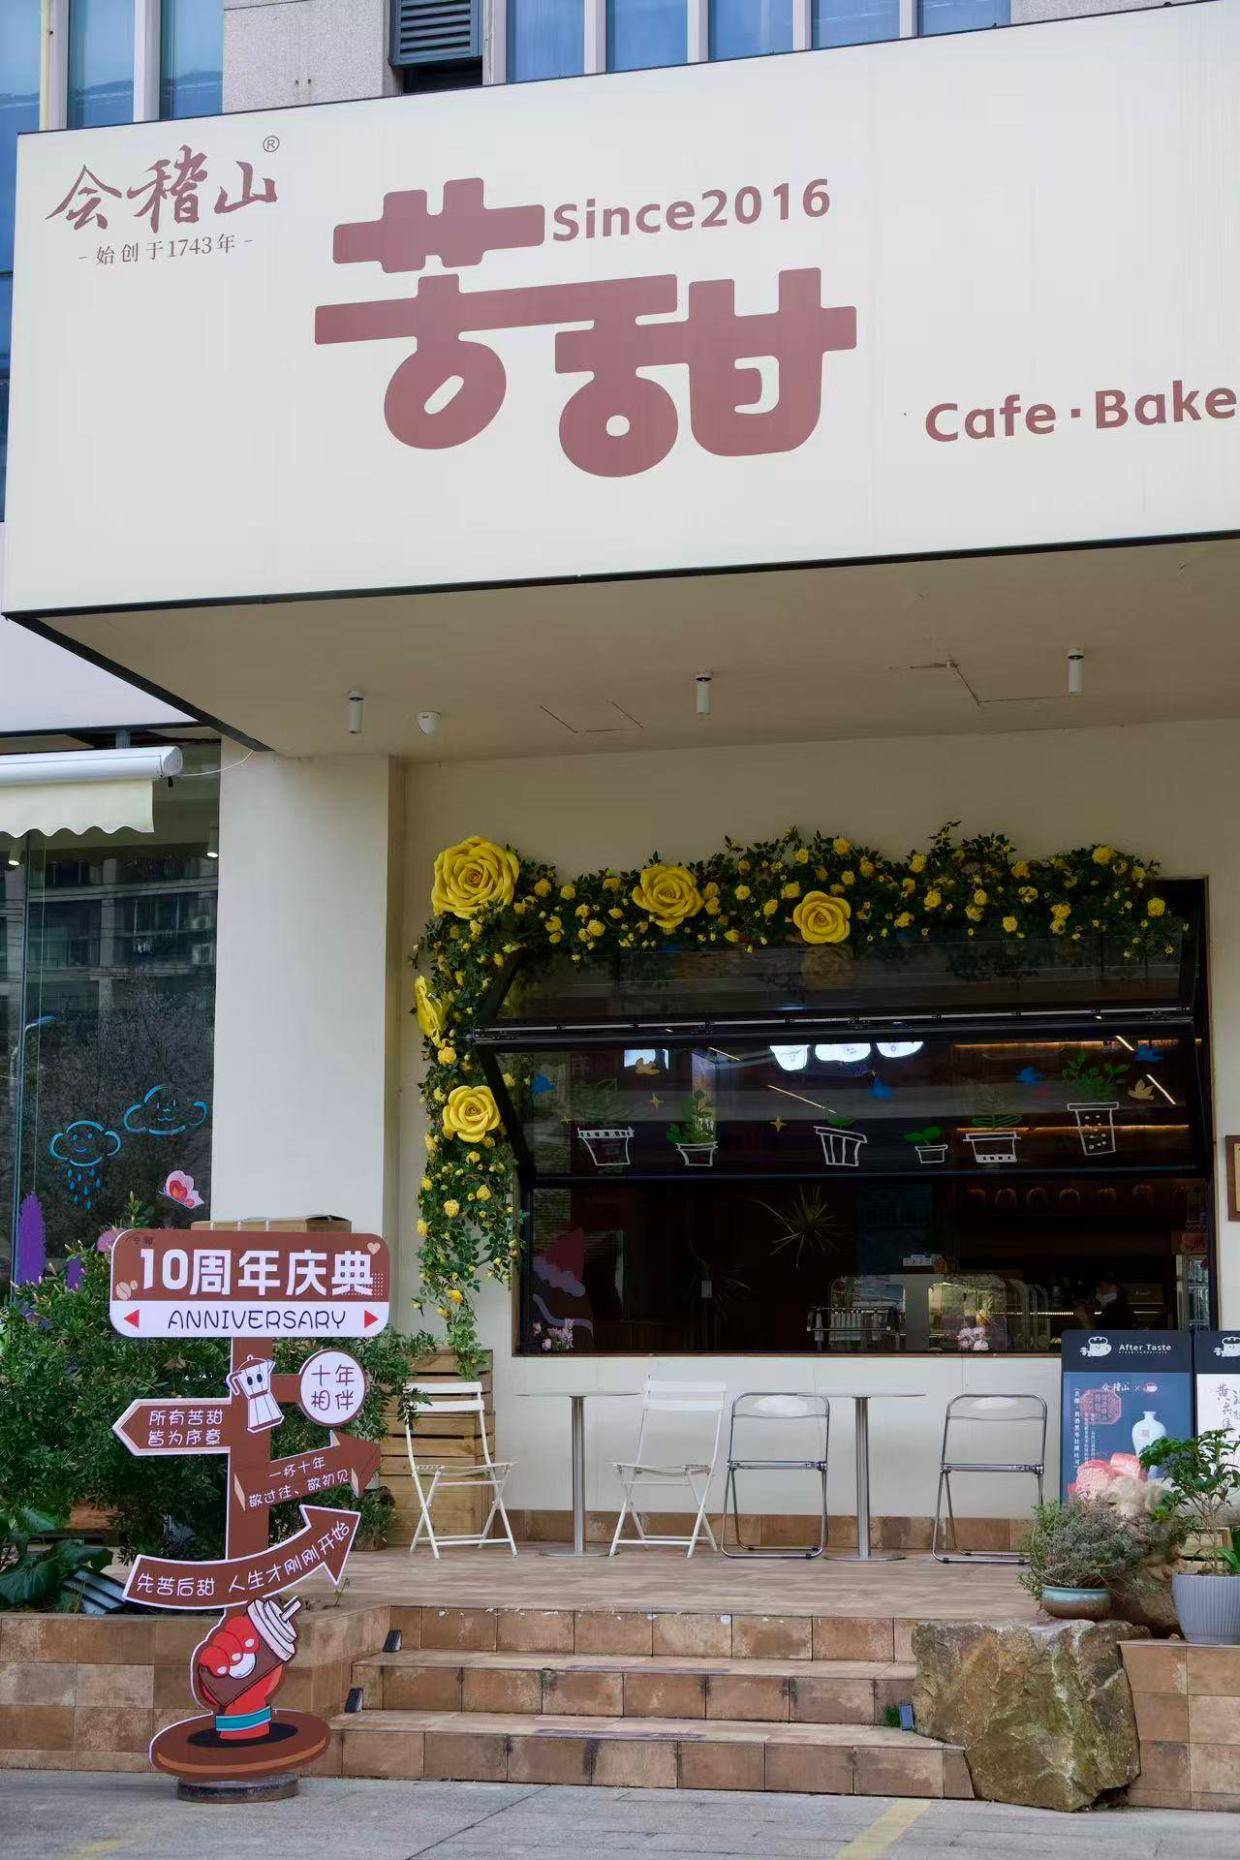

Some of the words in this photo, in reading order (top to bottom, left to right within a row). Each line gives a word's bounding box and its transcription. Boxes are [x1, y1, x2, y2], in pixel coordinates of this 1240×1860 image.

[45, 144, 278, 234] 会稽山
[552, 178, 831, 242] Since2016
[140, 1248, 375, 1297] 10周年庆典
[168, 1309, 347, 1330] ANNIVERSARY
[1119, 1343, 1144, 1352] After
[1146, 1343, 1173, 1352] Taste
[311, 1364, 356, 1387] 十年
[311, 1389, 355, 1412] 相伴
[148, 1408, 224, 1427] 所有苦甜
[147, 1428, 222, 1447] 皆为序章
[268, 1456, 327, 1478] 一杯十年
[135, 1572, 216, 1598] 先苦后甜
[227, 1519, 351, 1593] 人生才刚刚开始
